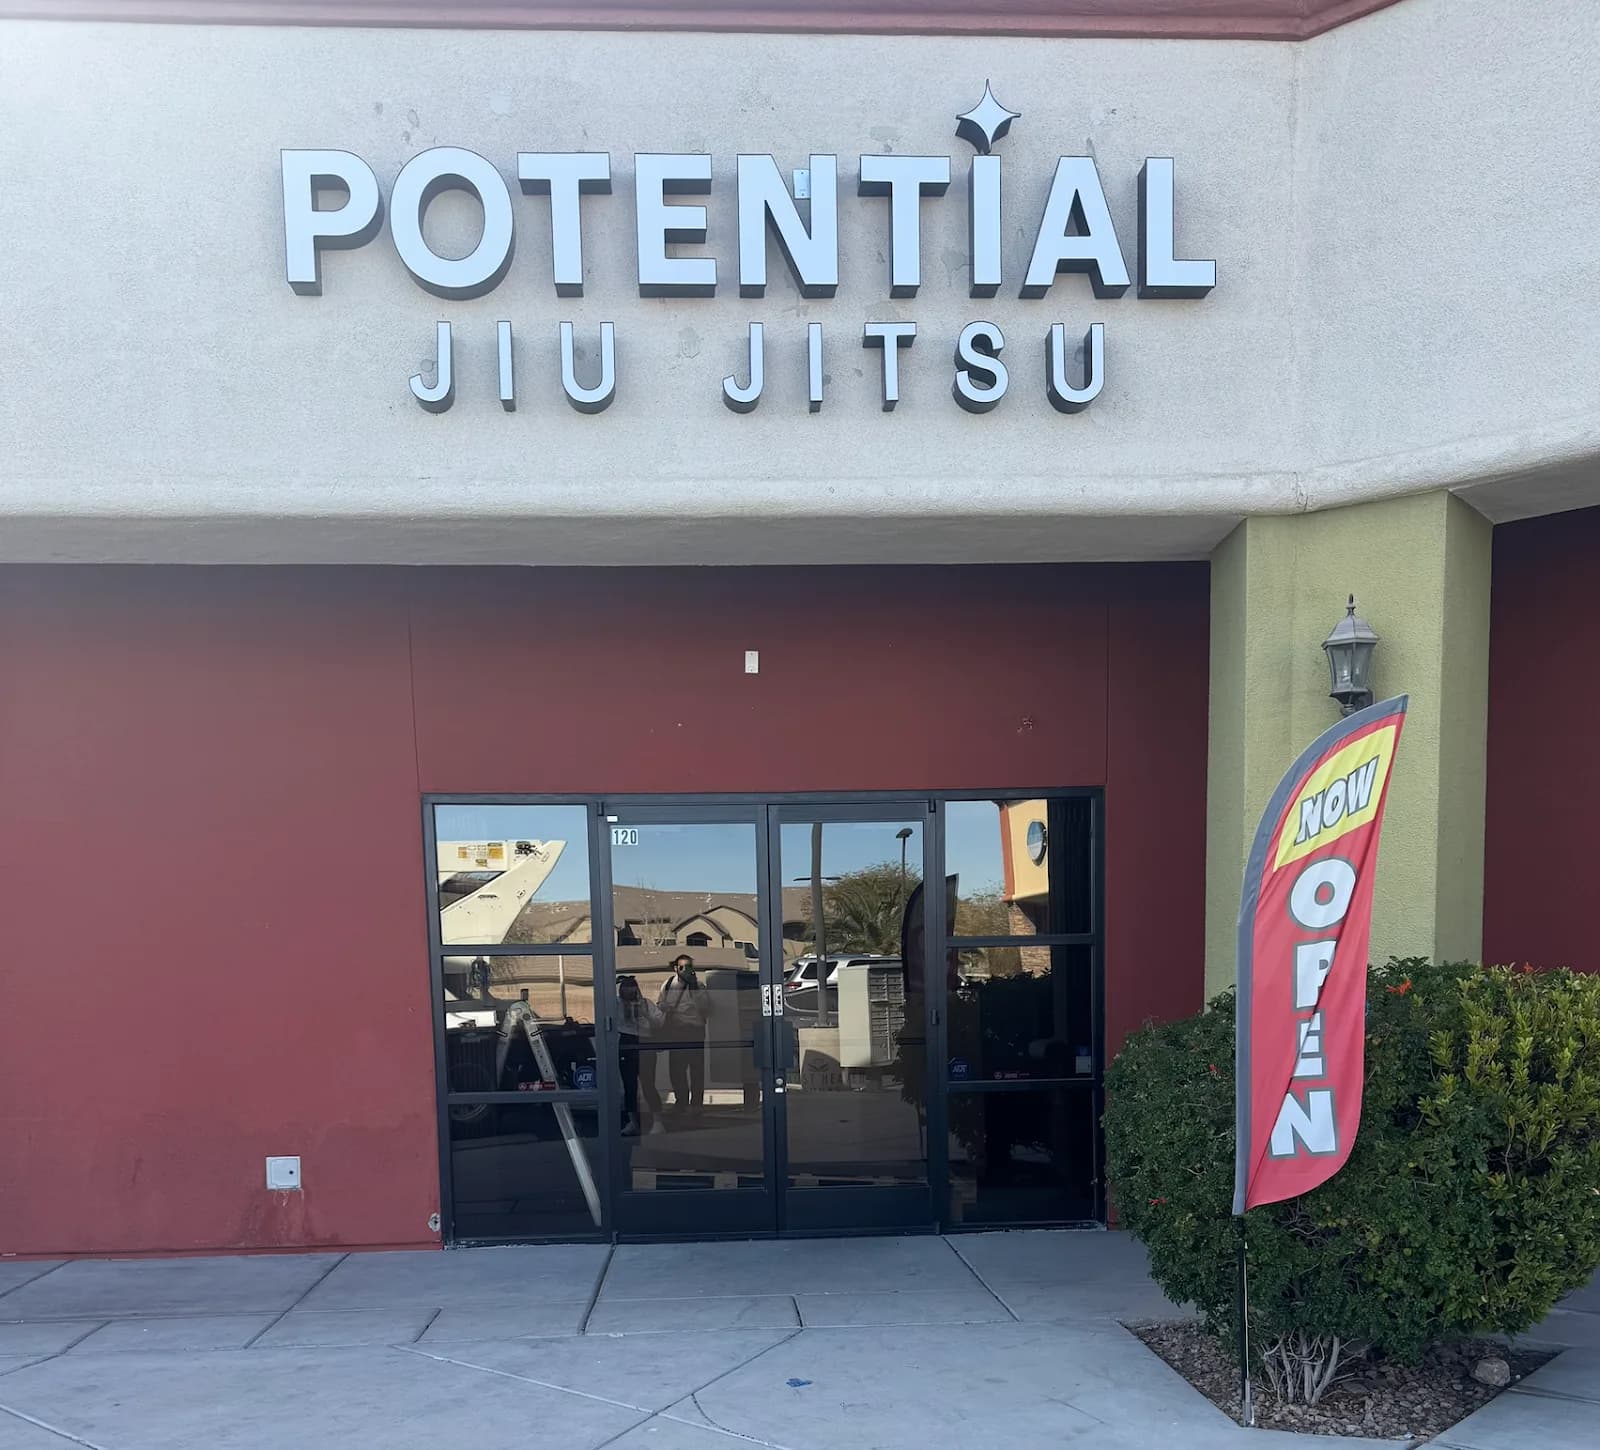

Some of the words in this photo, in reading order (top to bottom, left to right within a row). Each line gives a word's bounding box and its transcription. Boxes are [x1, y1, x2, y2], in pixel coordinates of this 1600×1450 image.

[280, 146, 1217, 294] POTENTIAL
[408, 320, 617, 408] JIU
[722, 320, 1106, 408] JITSU
[614, 829, 637, 845] 120
[1293, 754, 1380, 846] NOW
[1268, 856, 1358, 1157] OPEN
